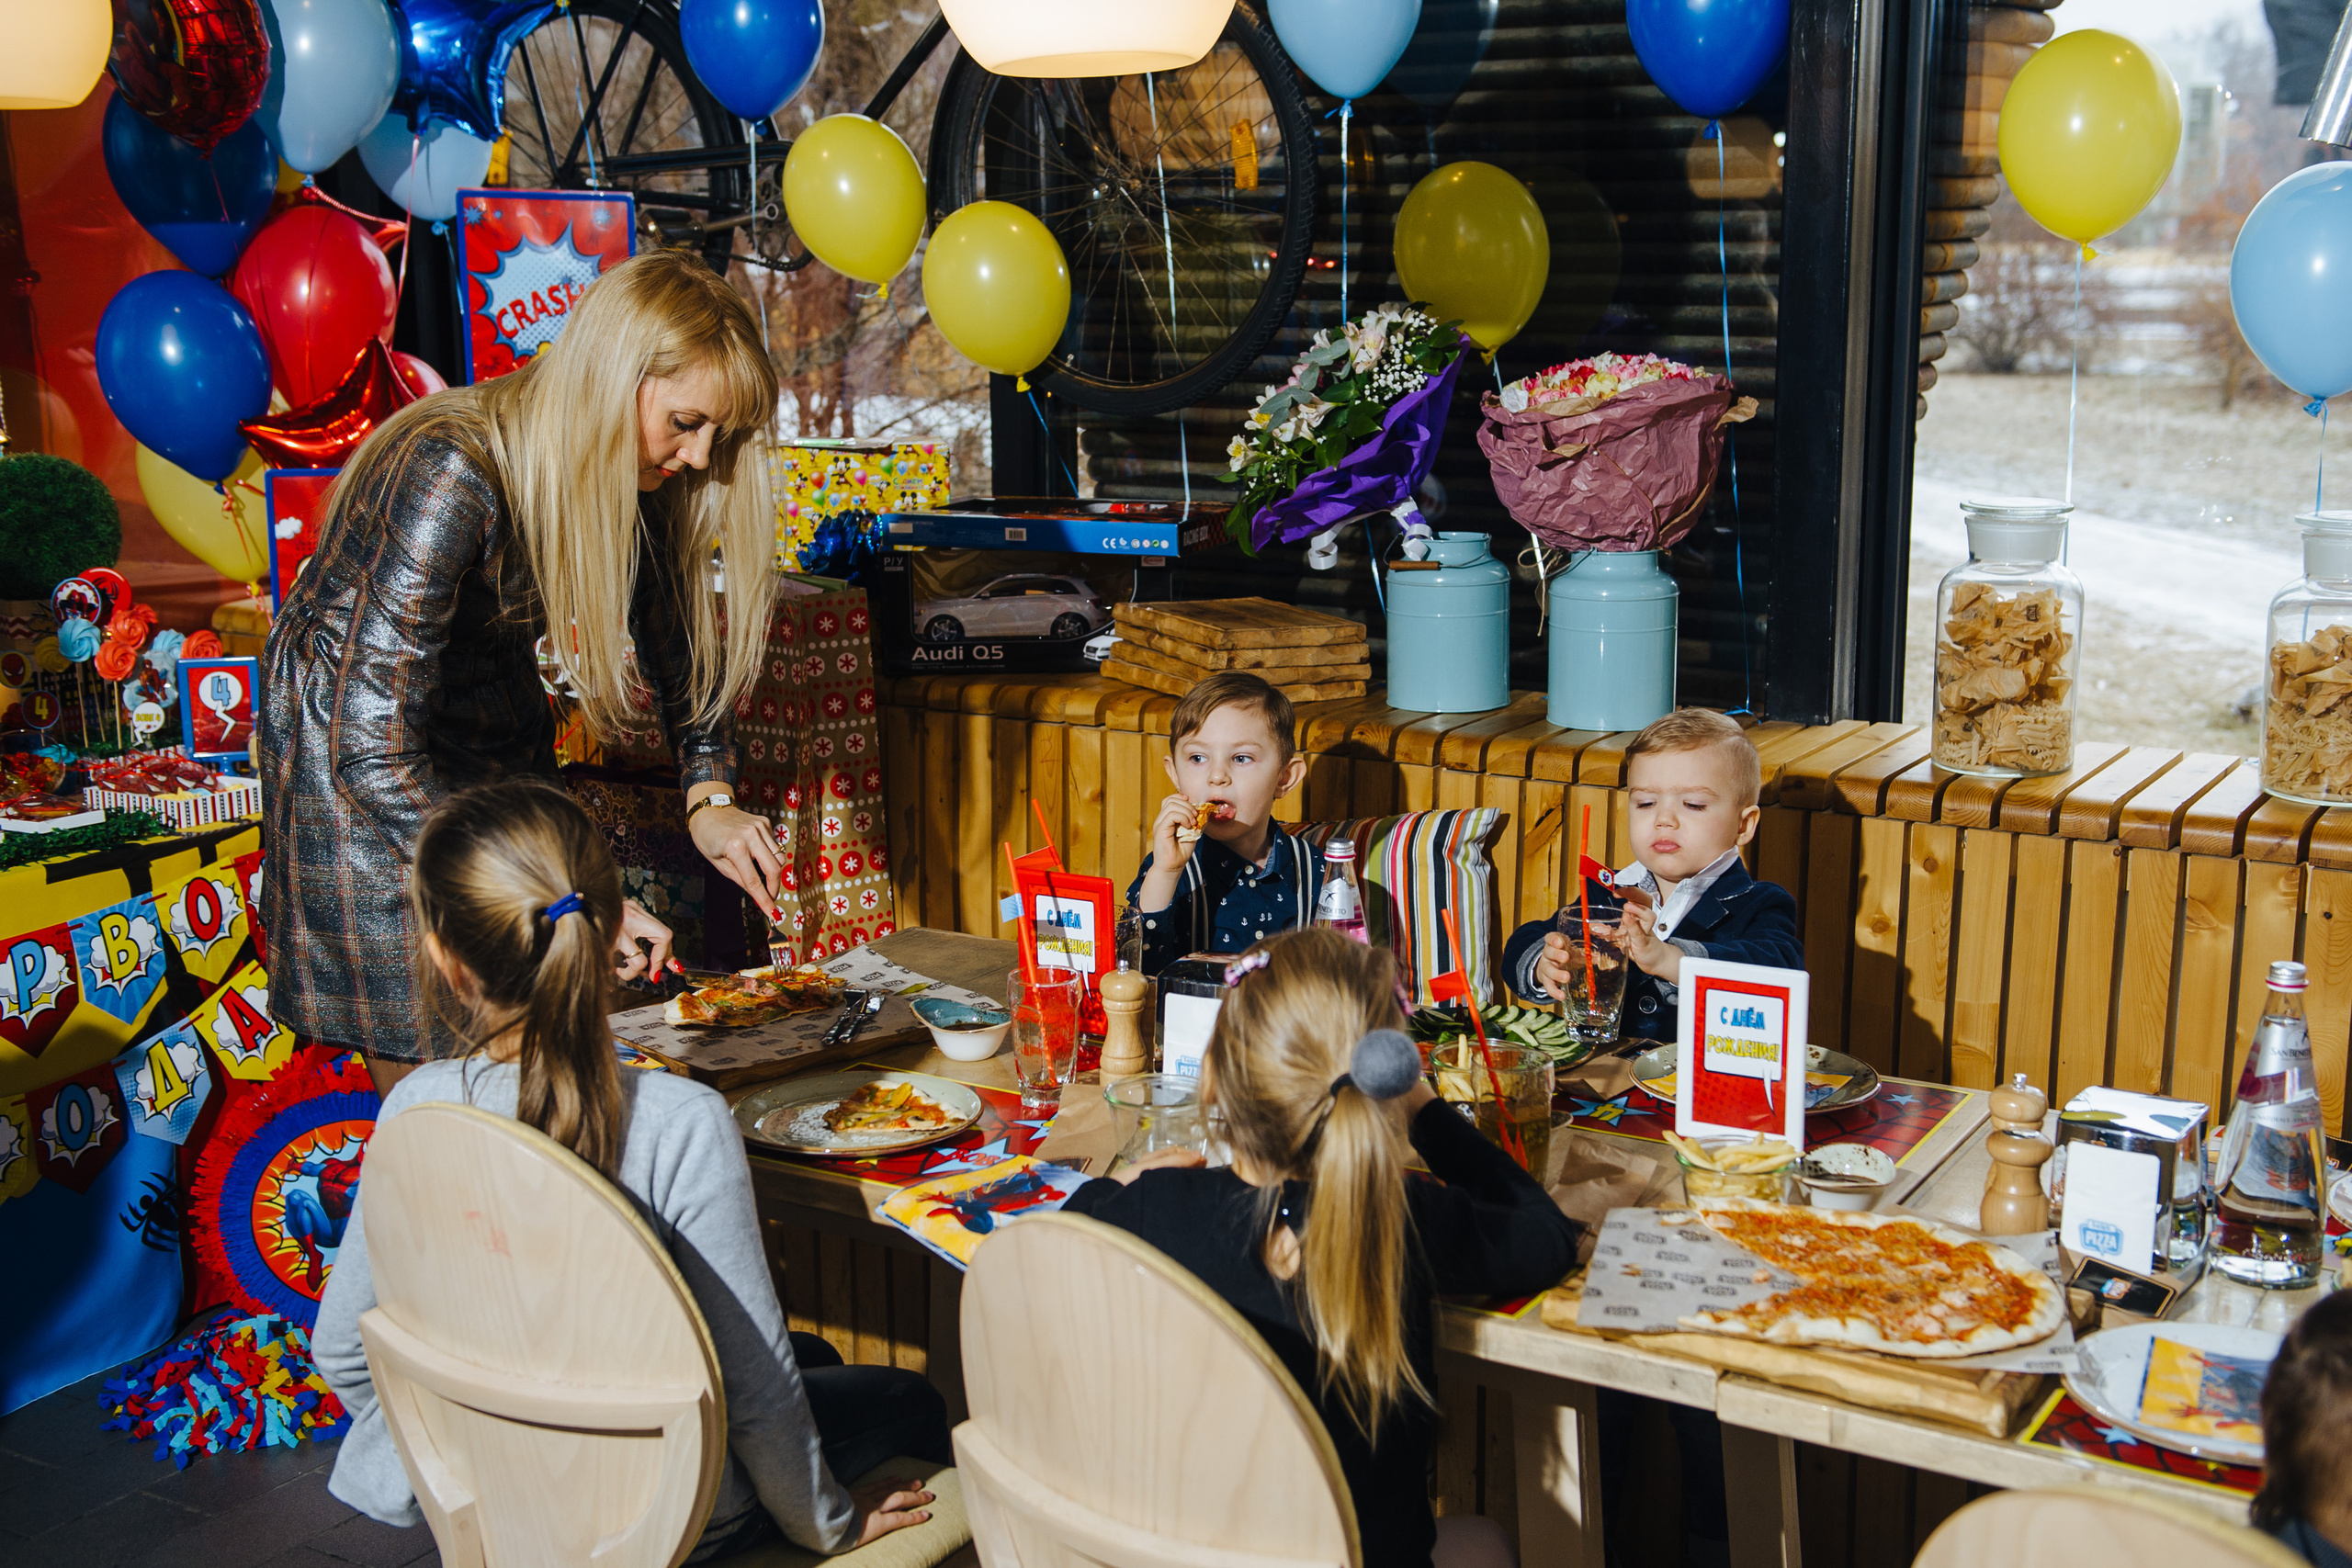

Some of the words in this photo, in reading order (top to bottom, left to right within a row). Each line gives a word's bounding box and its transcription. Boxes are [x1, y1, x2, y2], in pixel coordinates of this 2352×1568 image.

[911, 646, 963, 660] Audi
[972, 645, 1004, 660] Q5
[211, 675, 231, 706] 4
[35, 695, 48, 720] 4
[1055, 908, 1082, 930] ДНЁМ
[1038, 934, 1093, 957] РОЖДЕНИЯ!
[1730, 1007, 1766, 1031] ДНЁМ
[1707, 1033, 1781, 1063] РОЖДЕНИЯ!
[2084, 1230, 2118, 1250] PIZZA
